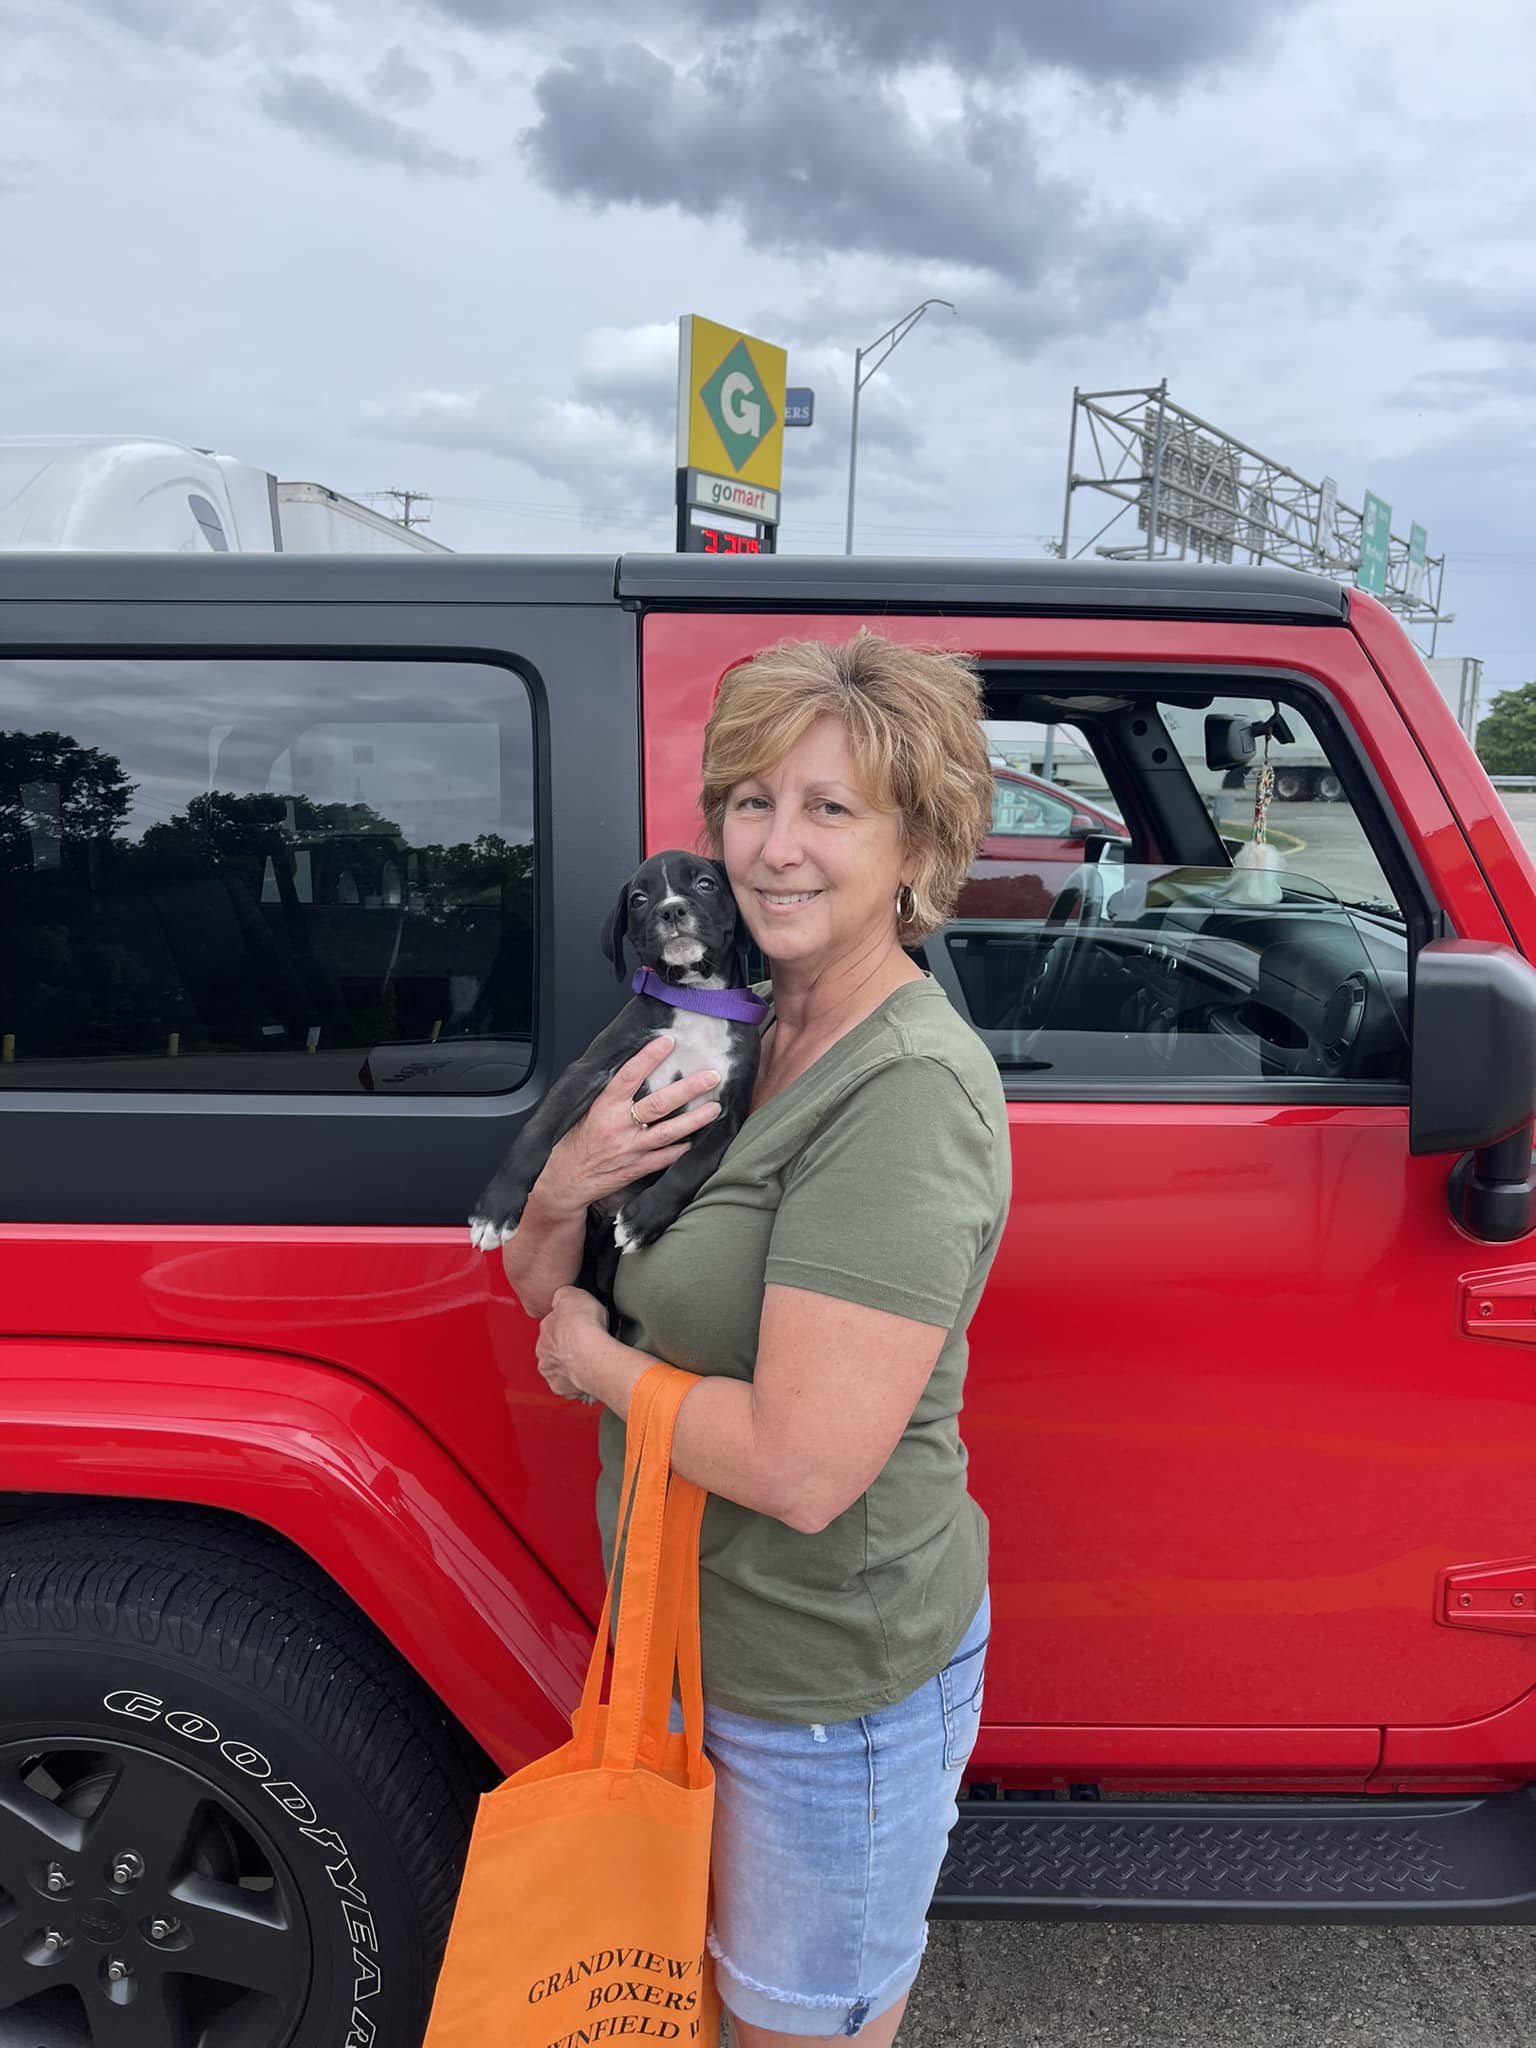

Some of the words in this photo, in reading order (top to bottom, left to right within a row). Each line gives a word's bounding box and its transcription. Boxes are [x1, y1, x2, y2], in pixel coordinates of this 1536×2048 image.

[721, 371, 761, 438] G
[712, 482, 766, 511] gomart
[104, 1690, 381, 2048] GOODYEAR
[528, 1948, 693, 2004] GRANDVIEW
[586, 1981, 697, 2012] BOXERS
